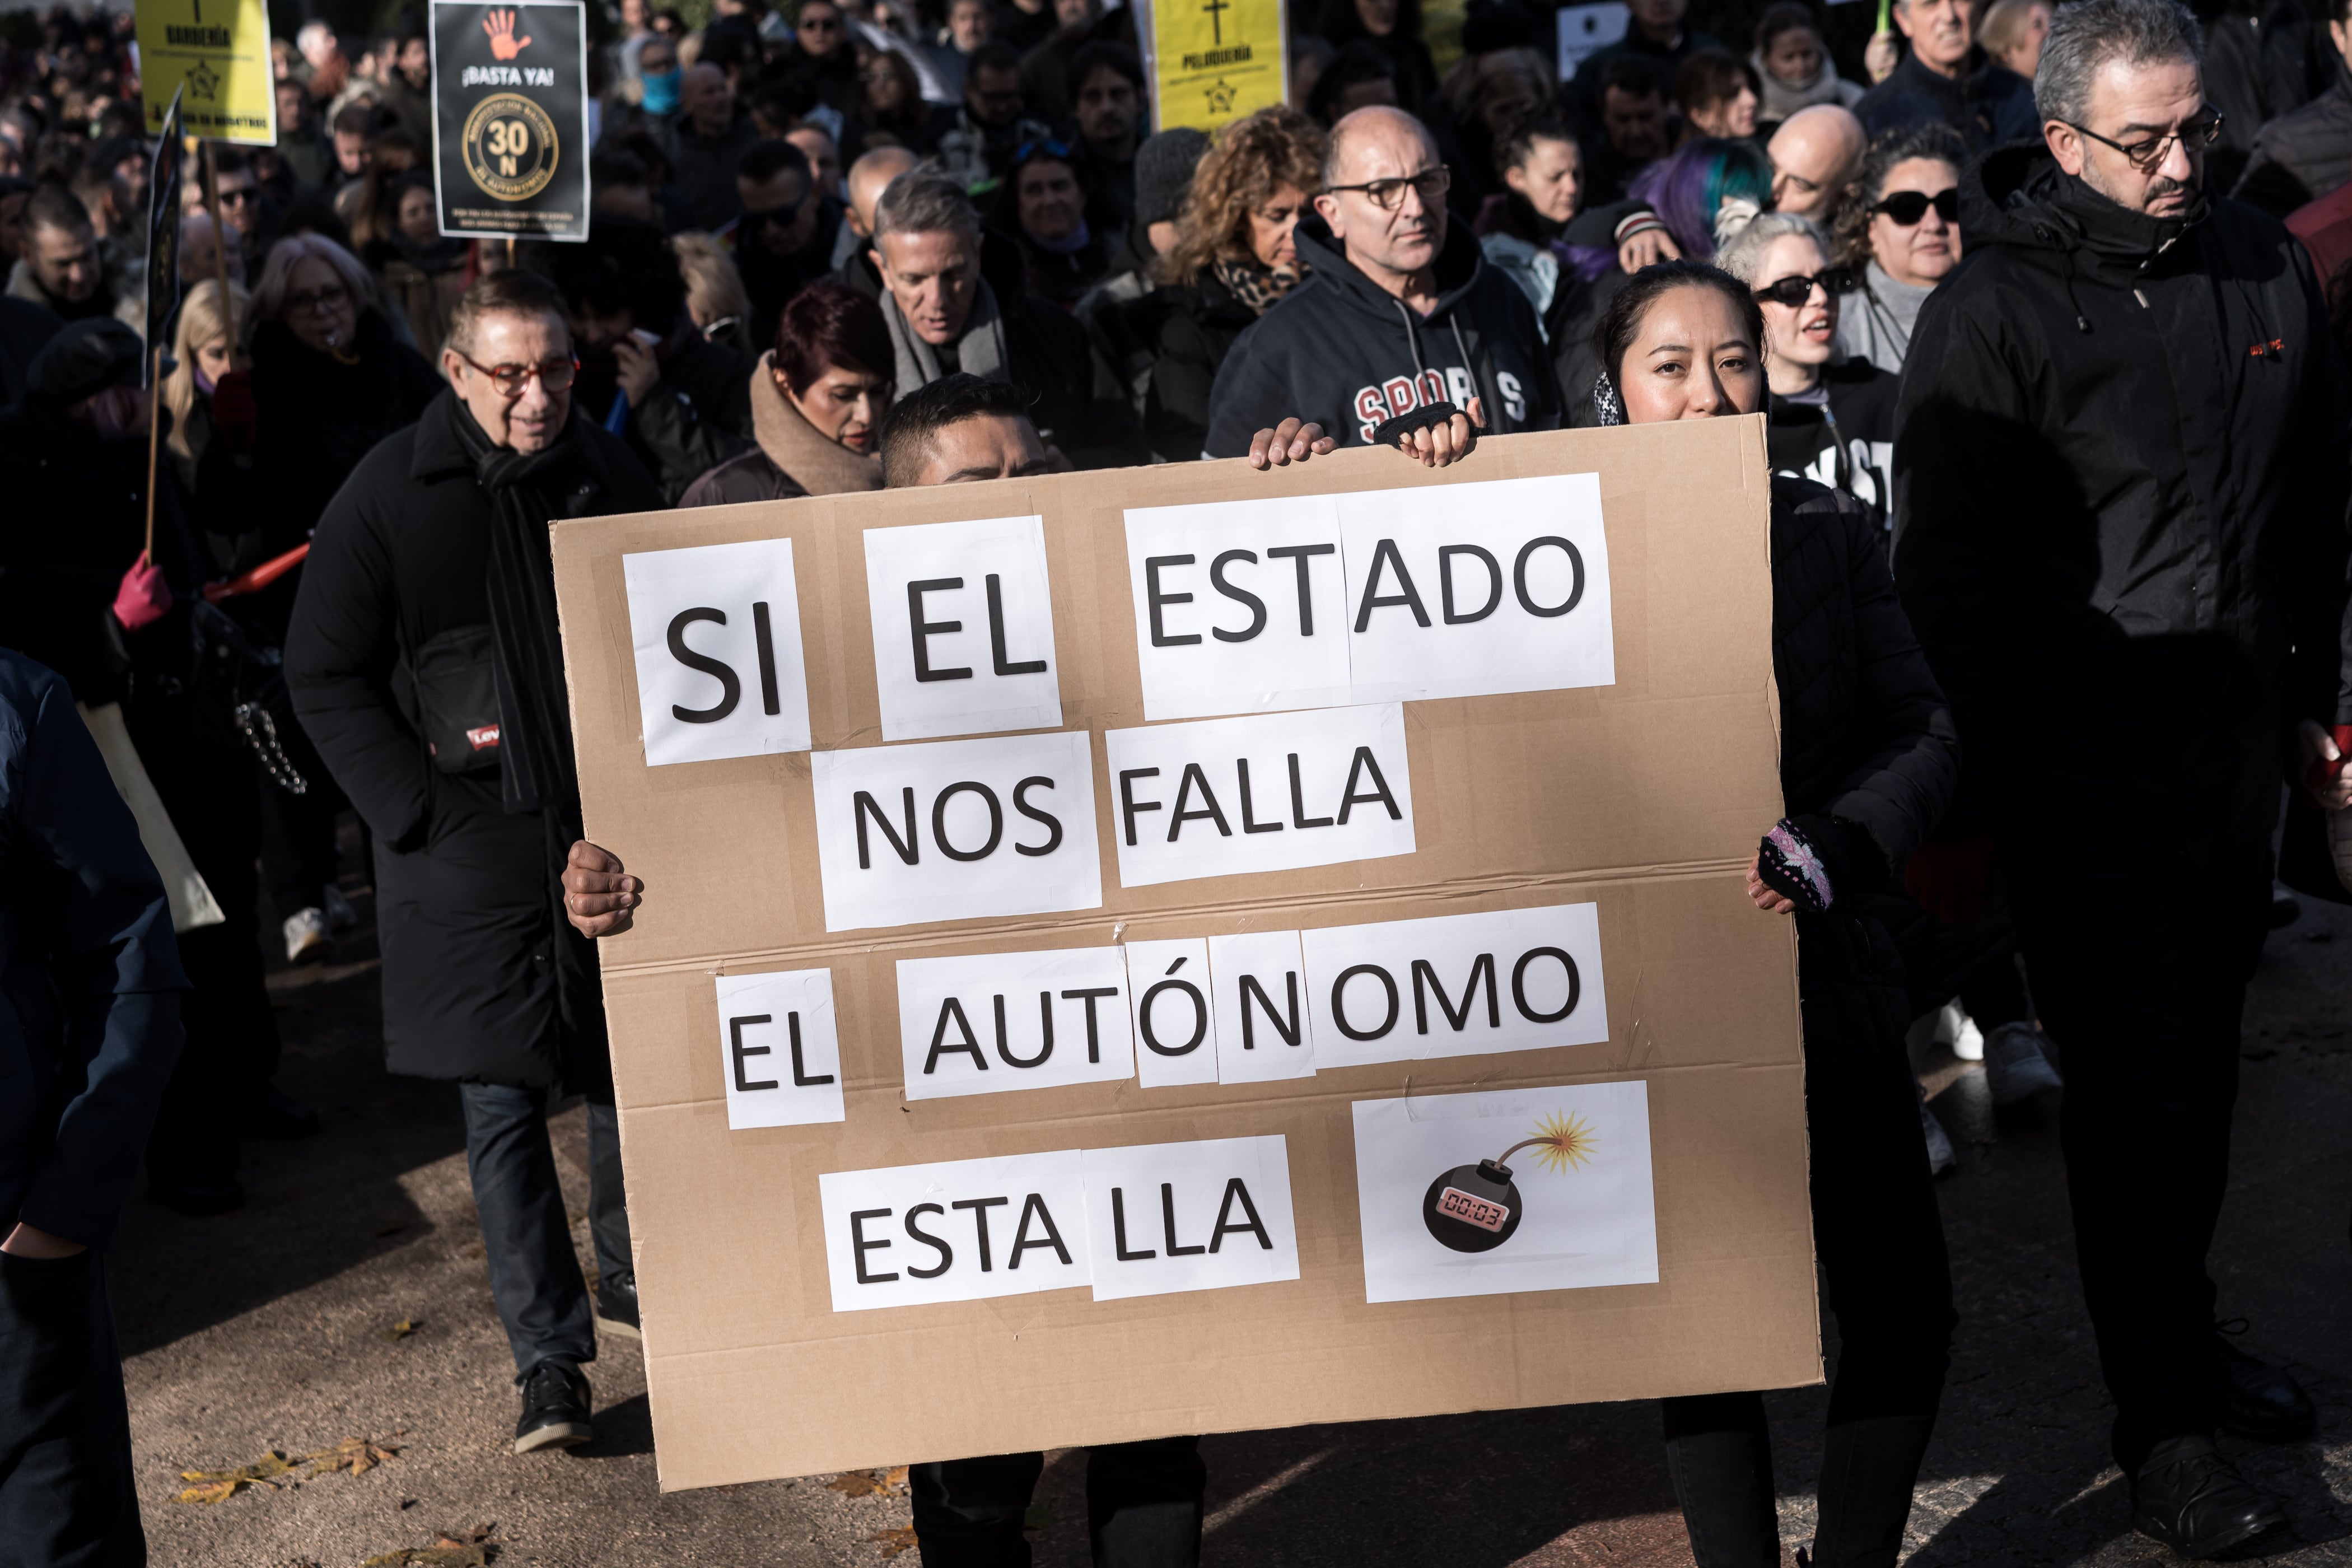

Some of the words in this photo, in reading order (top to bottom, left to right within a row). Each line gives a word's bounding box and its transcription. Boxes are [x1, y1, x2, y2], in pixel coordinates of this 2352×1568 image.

[1182, 43, 1252, 70] PELUQUERÍA
[462, 66, 522, 87] ¡BASTA
[524, 67, 554, 87] YA!
[487, 119, 529, 156] 30
[500, 155, 517, 177] N
[1354, 367, 1525, 445] SPORS
[666, 601, 780, 724] SI
[907, 573, 1047, 683] EL
[1145, 536, 1585, 647] ESTADO
[853, 776, 1063, 869] NOS
[1119, 746, 1402, 846] FALLA
[729, 1011, 834, 1091] EL
[923, 946, 1580, 1075] AUTÓNOMO
[1444, 1193, 1501, 1226] 00:03
